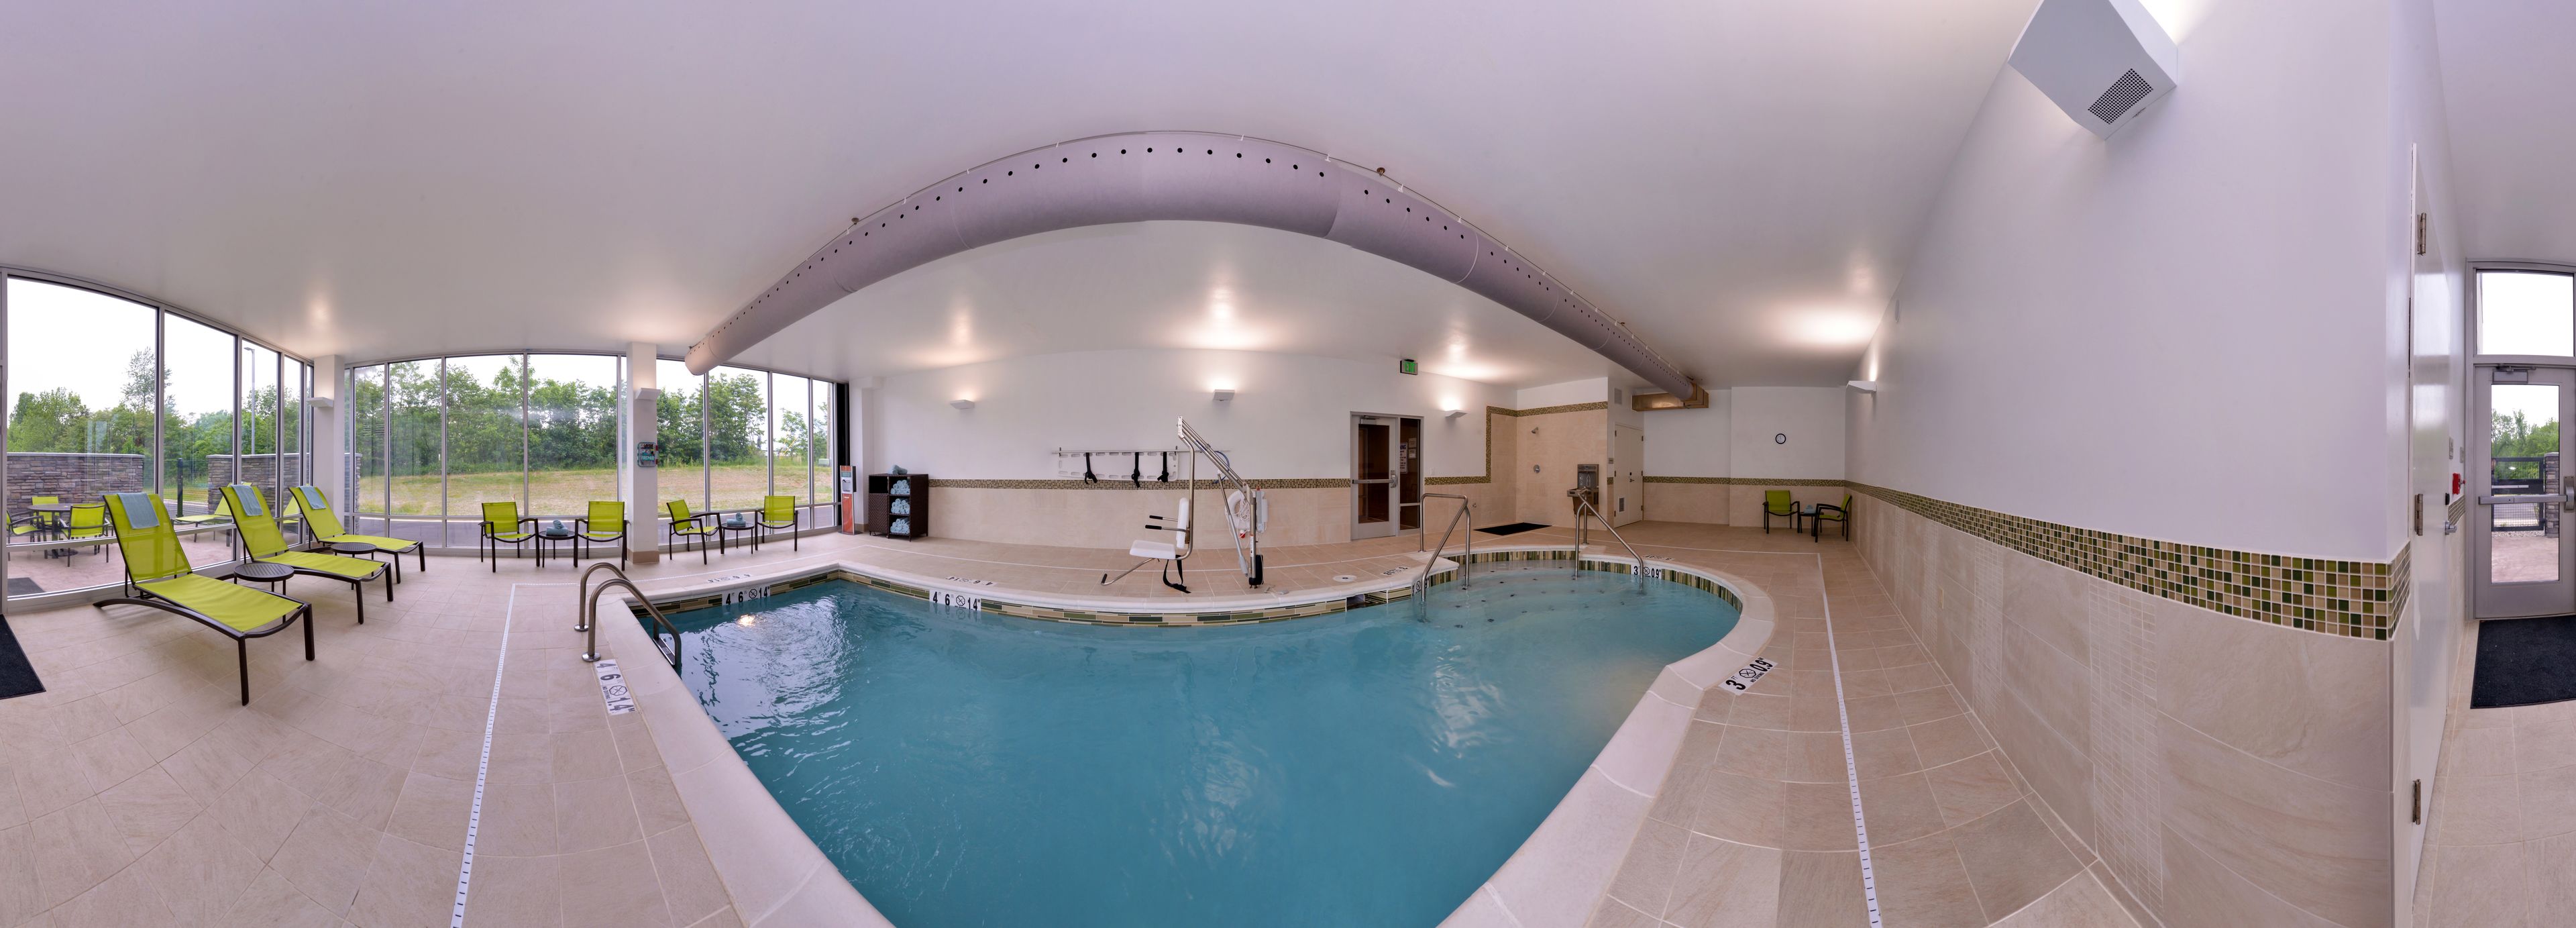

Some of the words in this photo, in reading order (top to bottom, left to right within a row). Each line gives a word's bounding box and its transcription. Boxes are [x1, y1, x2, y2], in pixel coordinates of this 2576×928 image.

[726, 593, 731, 605] 4
[739, 591, 743, 603] 6
[933, 591, 938, 603] 4
[945, 594, 950, 605] 6
[1725, 680, 1746, 690] 3
